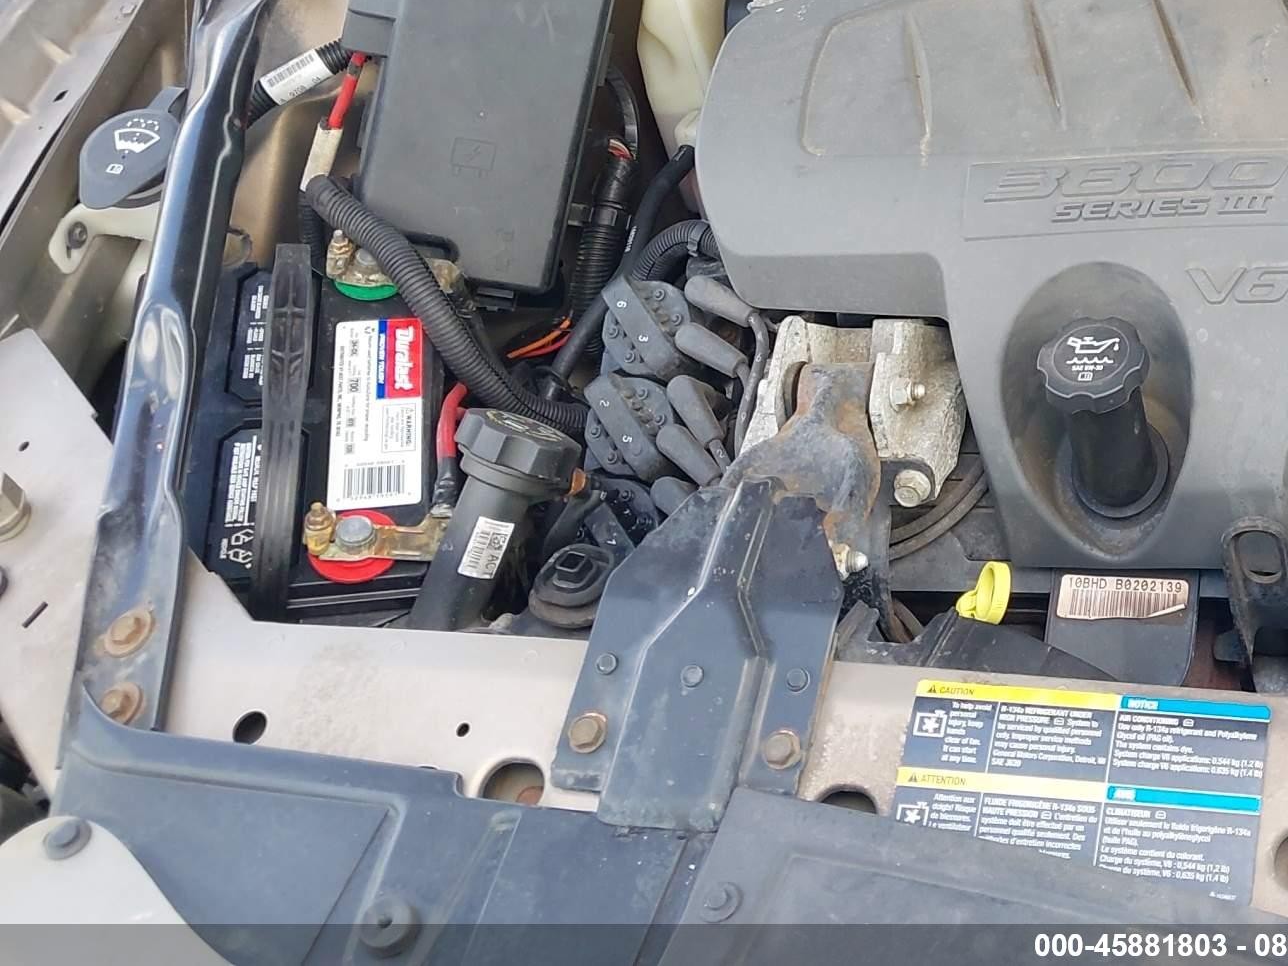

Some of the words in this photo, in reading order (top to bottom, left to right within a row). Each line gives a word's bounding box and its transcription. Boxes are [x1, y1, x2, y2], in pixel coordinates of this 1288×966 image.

[1051, 197, 1211, 222] SERIES
[1217, 194, 1273, 215] III
[394, 326, 413, 391] Duralast
[349, 378, 358, 392] 700
[1069, 577, 1107, 589] 10BHD
[1115, 578, 1182, 593] B0202139
[939, 686, 974, 695] CAUTION
